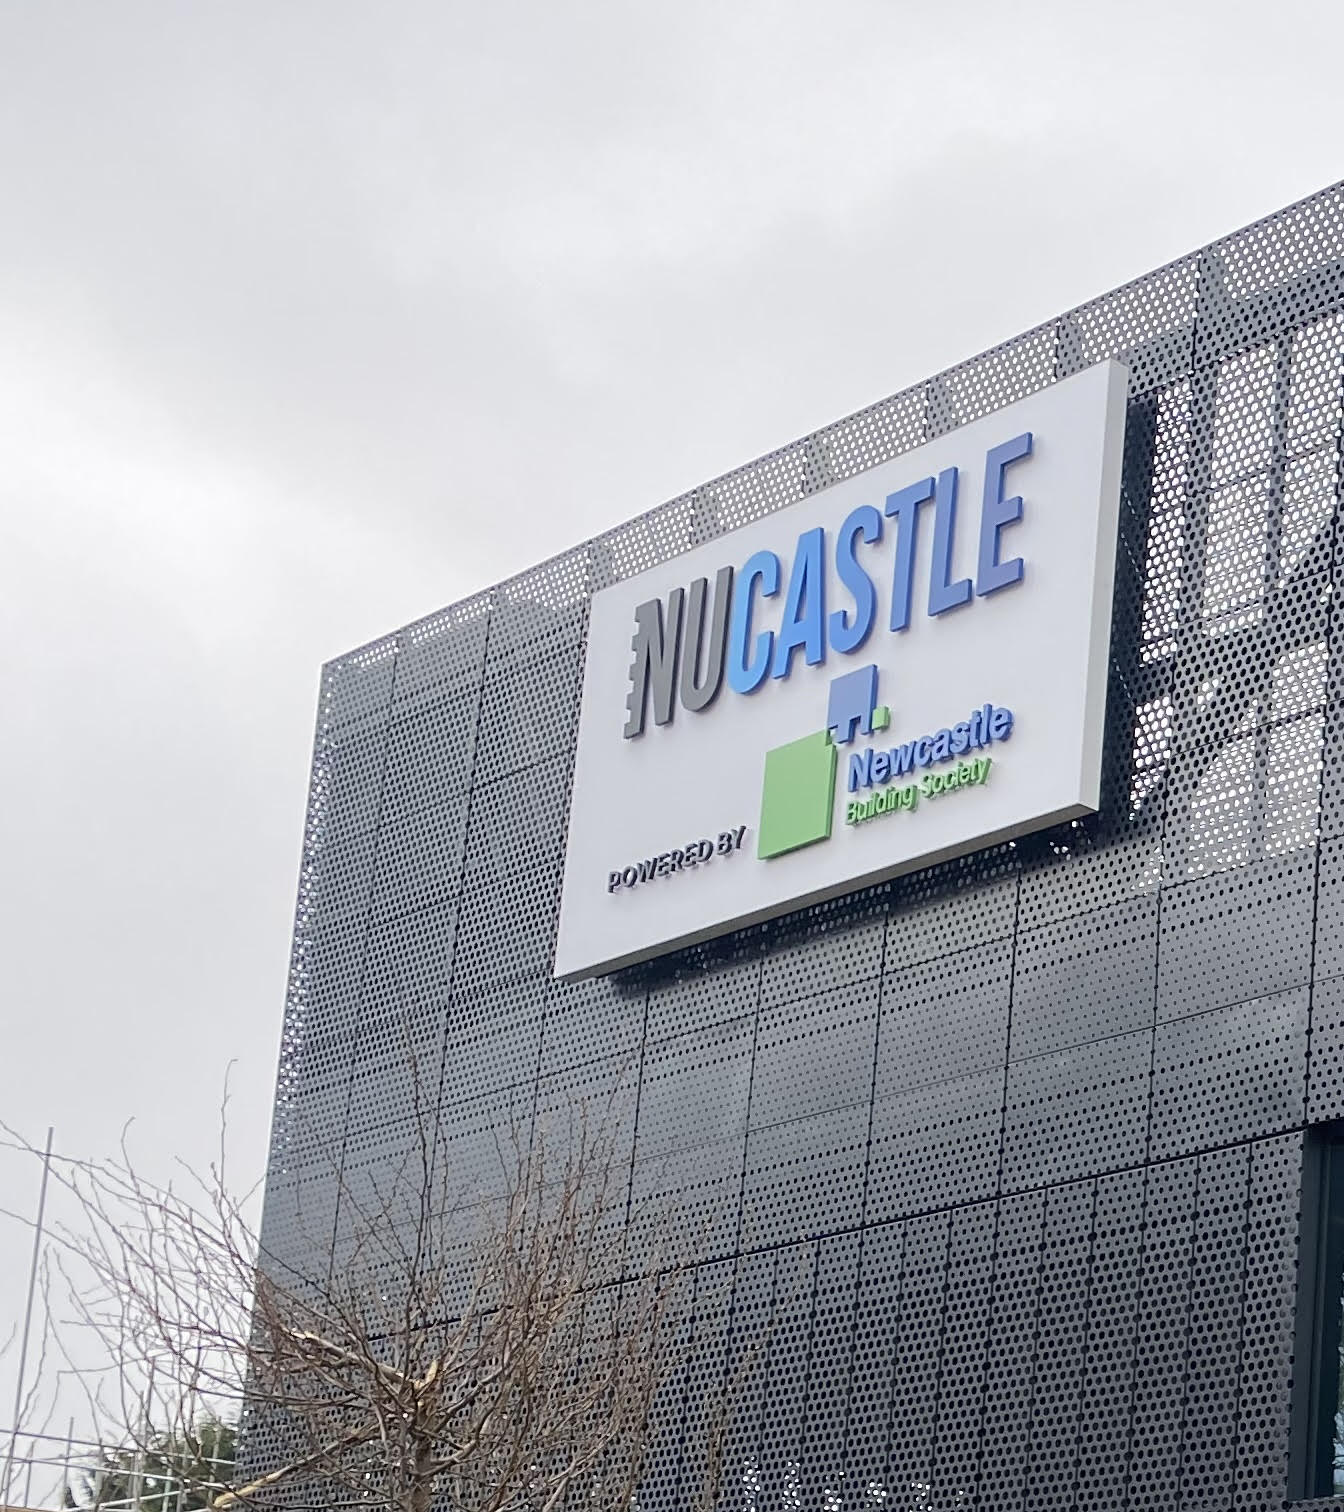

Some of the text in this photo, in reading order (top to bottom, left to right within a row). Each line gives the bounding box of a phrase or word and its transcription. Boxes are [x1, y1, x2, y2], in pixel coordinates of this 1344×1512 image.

[623, 432, 1033, 739] NUCASTLE
[848, 703, 1014, 793] Newcastle
[846, 757, 992, 825] Building Society
[608, 825, 747, 893] POWERED BY
